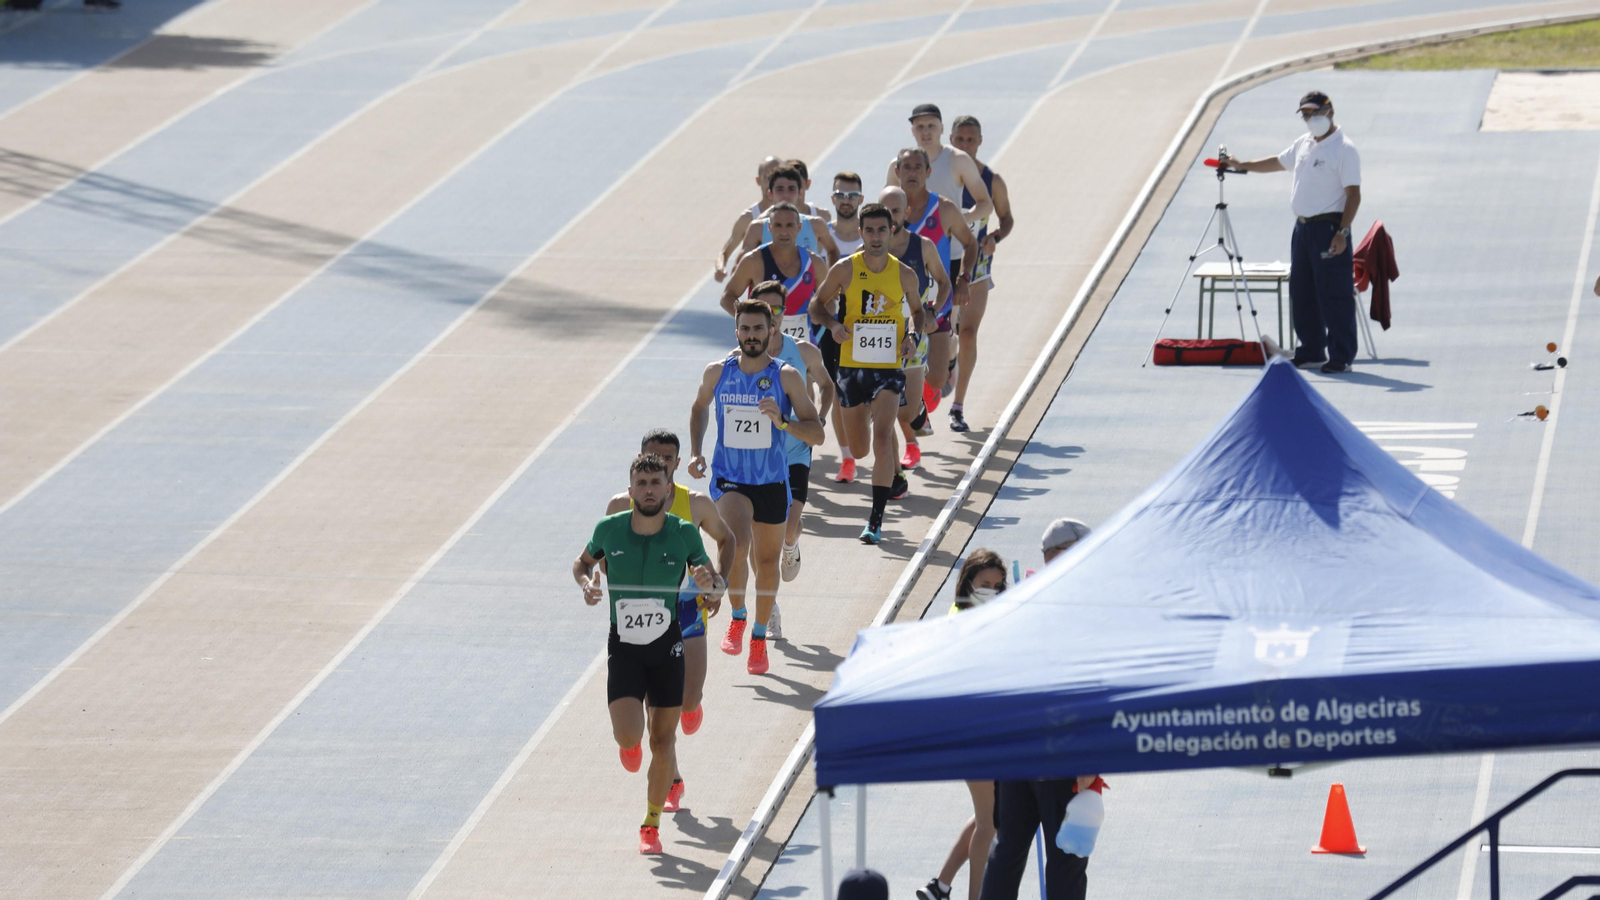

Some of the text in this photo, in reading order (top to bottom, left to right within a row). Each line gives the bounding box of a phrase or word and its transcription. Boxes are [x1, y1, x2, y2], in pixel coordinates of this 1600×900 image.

[859, 336, 892, 349] 8415
[734, 419, 760, 434] 721
[624, 612, 665, 629] 2473
[1111, 697, 1421, 732] Ayuntamiento de Algeciras
[1136, 727, 1397, 756] Delegación de Deportes
